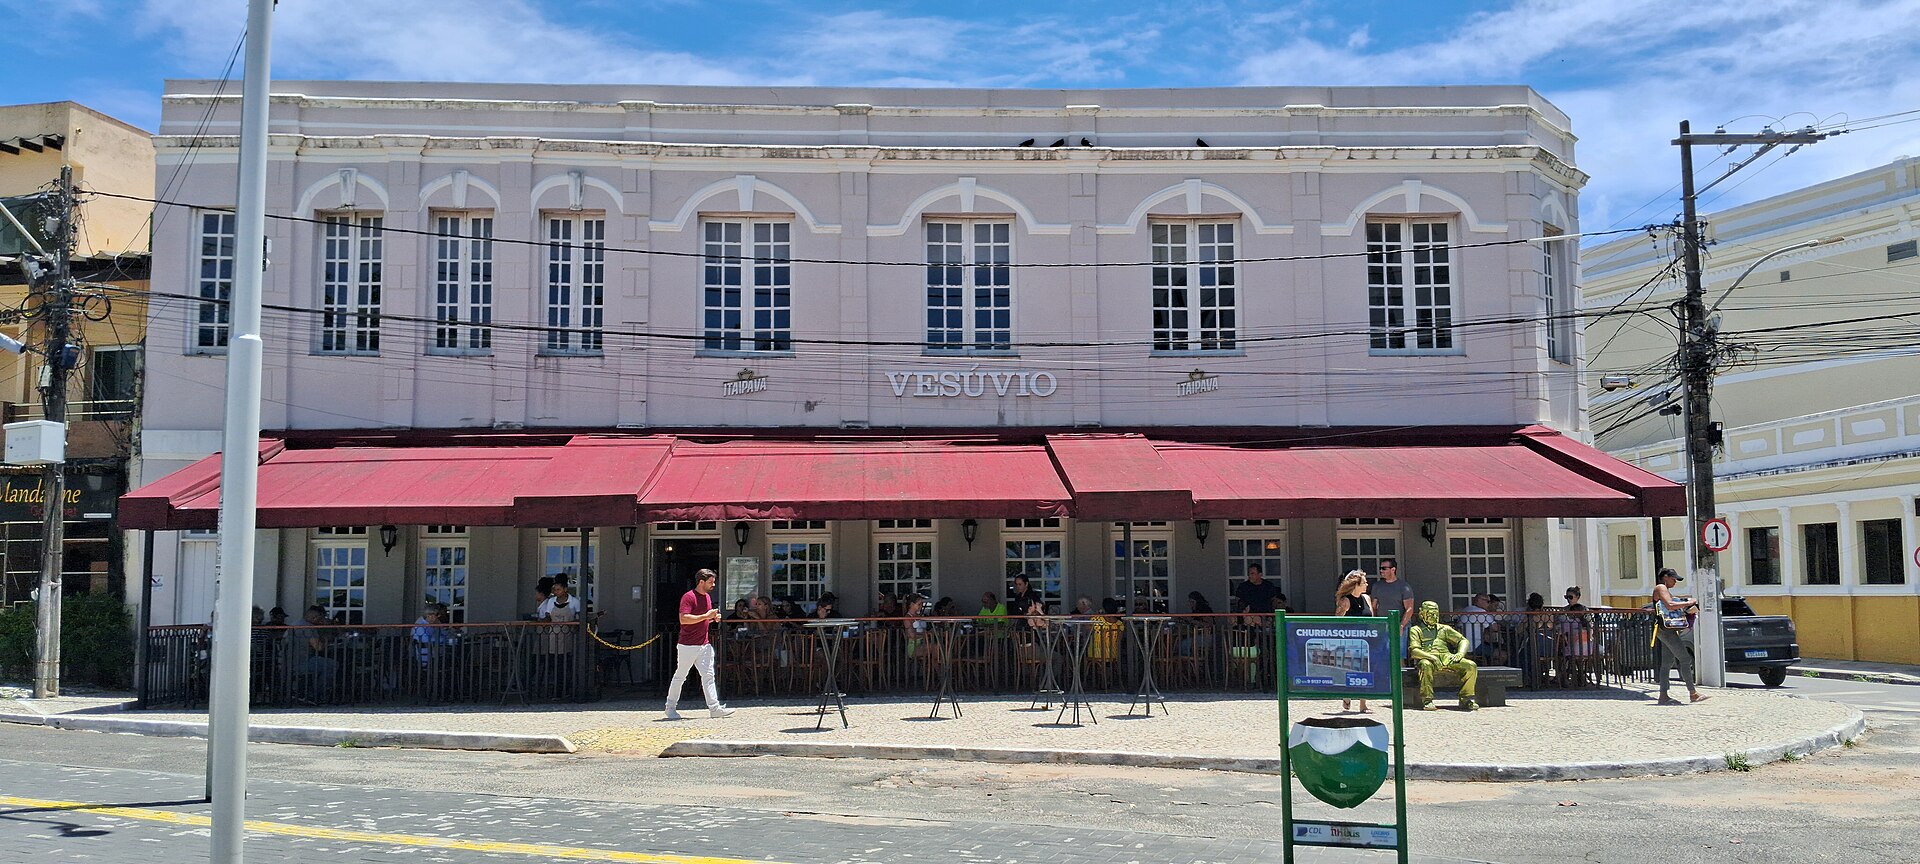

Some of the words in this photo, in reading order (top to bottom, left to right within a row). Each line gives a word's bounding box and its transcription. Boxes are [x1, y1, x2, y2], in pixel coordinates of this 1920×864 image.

[723, 377, 767, 397] ITAIPAVA
[884, 362, 1058, 398] VESÚVIO
[1176, 377, 1219, 397] ITAIPAVA
[1296, 628, 1378, 638] CHURRASQUEIRAS
[1349, 677, 1368, 686] 599
